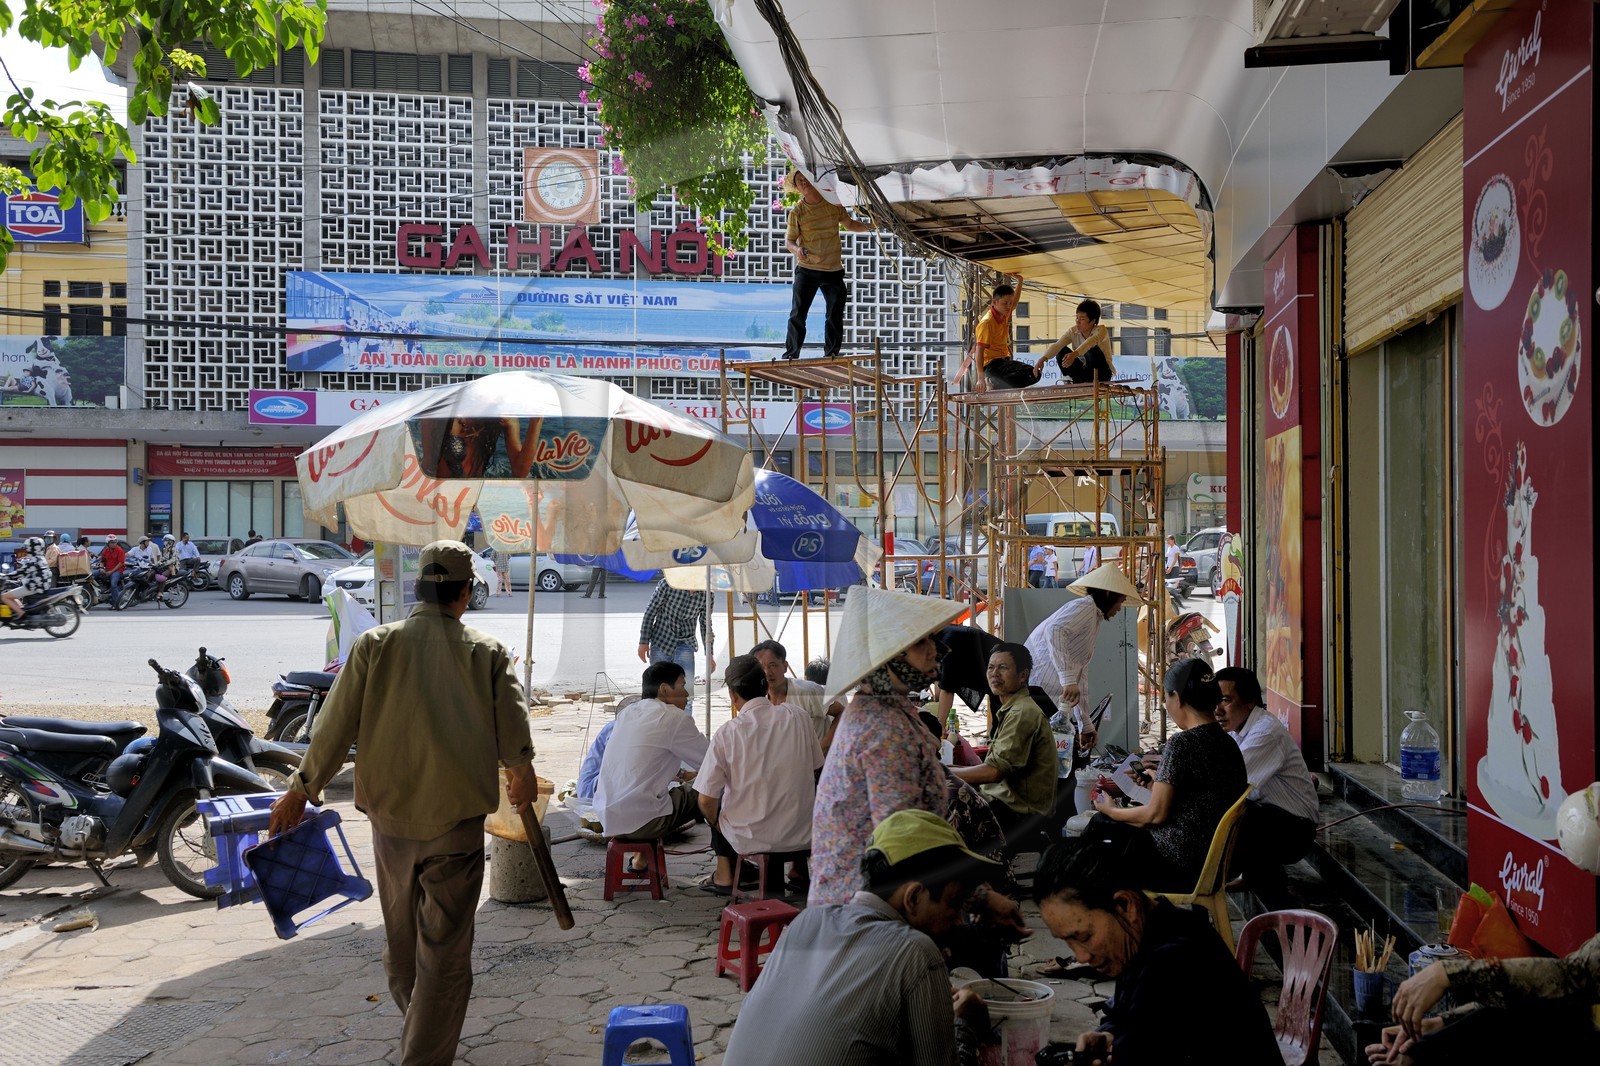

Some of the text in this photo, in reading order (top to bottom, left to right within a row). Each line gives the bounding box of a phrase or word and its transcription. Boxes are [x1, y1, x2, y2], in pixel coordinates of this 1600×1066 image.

[1495, 9, 1542, 113] Givral
[1506, 72, 1536, 107] since 1950
[10, 205, 61, 223] TOA
[397, 224, 493, 269] GA
[507, 219, 604, 273] HÀ
[517, 290, 570, 304] ĐƯỜNG
[574, 289, 604, 305] SẮT
[607, 292, 637, 307] VIỆT
[643, 296, 678, 306] NAM
[359, 353, 386, 365] AN
[391, 351, 439, 366] TOÀN
[444, 354, 487, 367] GIAO
[492, 353, 550, 369] THÔNG
[556, 353, 577, 369] LÀ
[583, 356, 630, 371] HẠNH
[636, 355, 682, 371] PHÚC
[687, 353, 721, 371] CỦA
[685, 403, 767, 420] KHÁCH
[793, 510, 832, 528] đồng
[1498, 851, 1544, 911] Givral
[1510, 897, 1539, 927] since 1950
